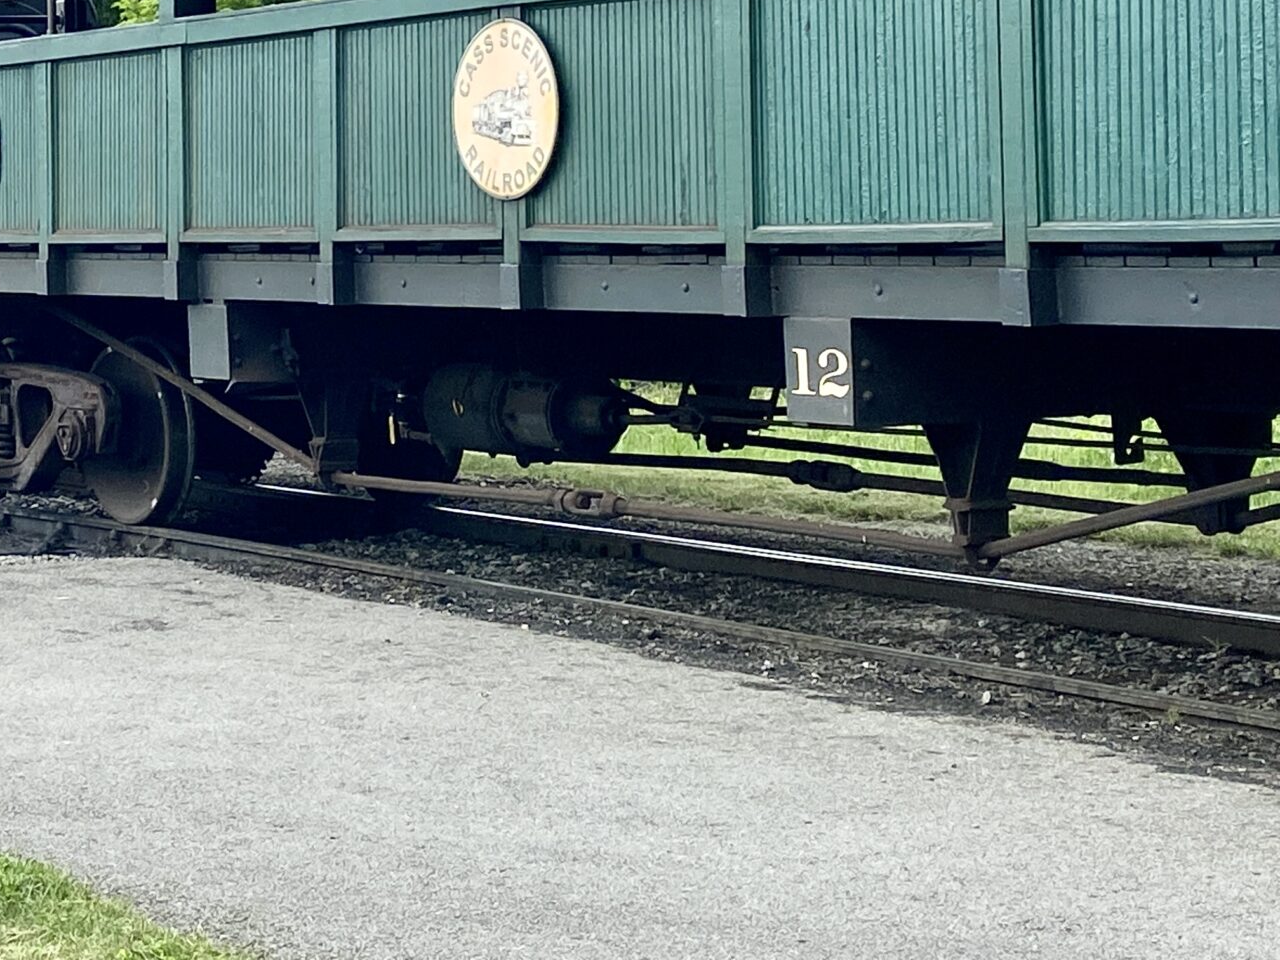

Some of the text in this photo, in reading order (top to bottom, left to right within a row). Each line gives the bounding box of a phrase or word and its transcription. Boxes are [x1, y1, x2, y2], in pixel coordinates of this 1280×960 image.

[458, 27, 552, 98] CASS SCENIC
[465, 144, 545, 193] RAILROAD
[790, 346, 850, 399] 12
